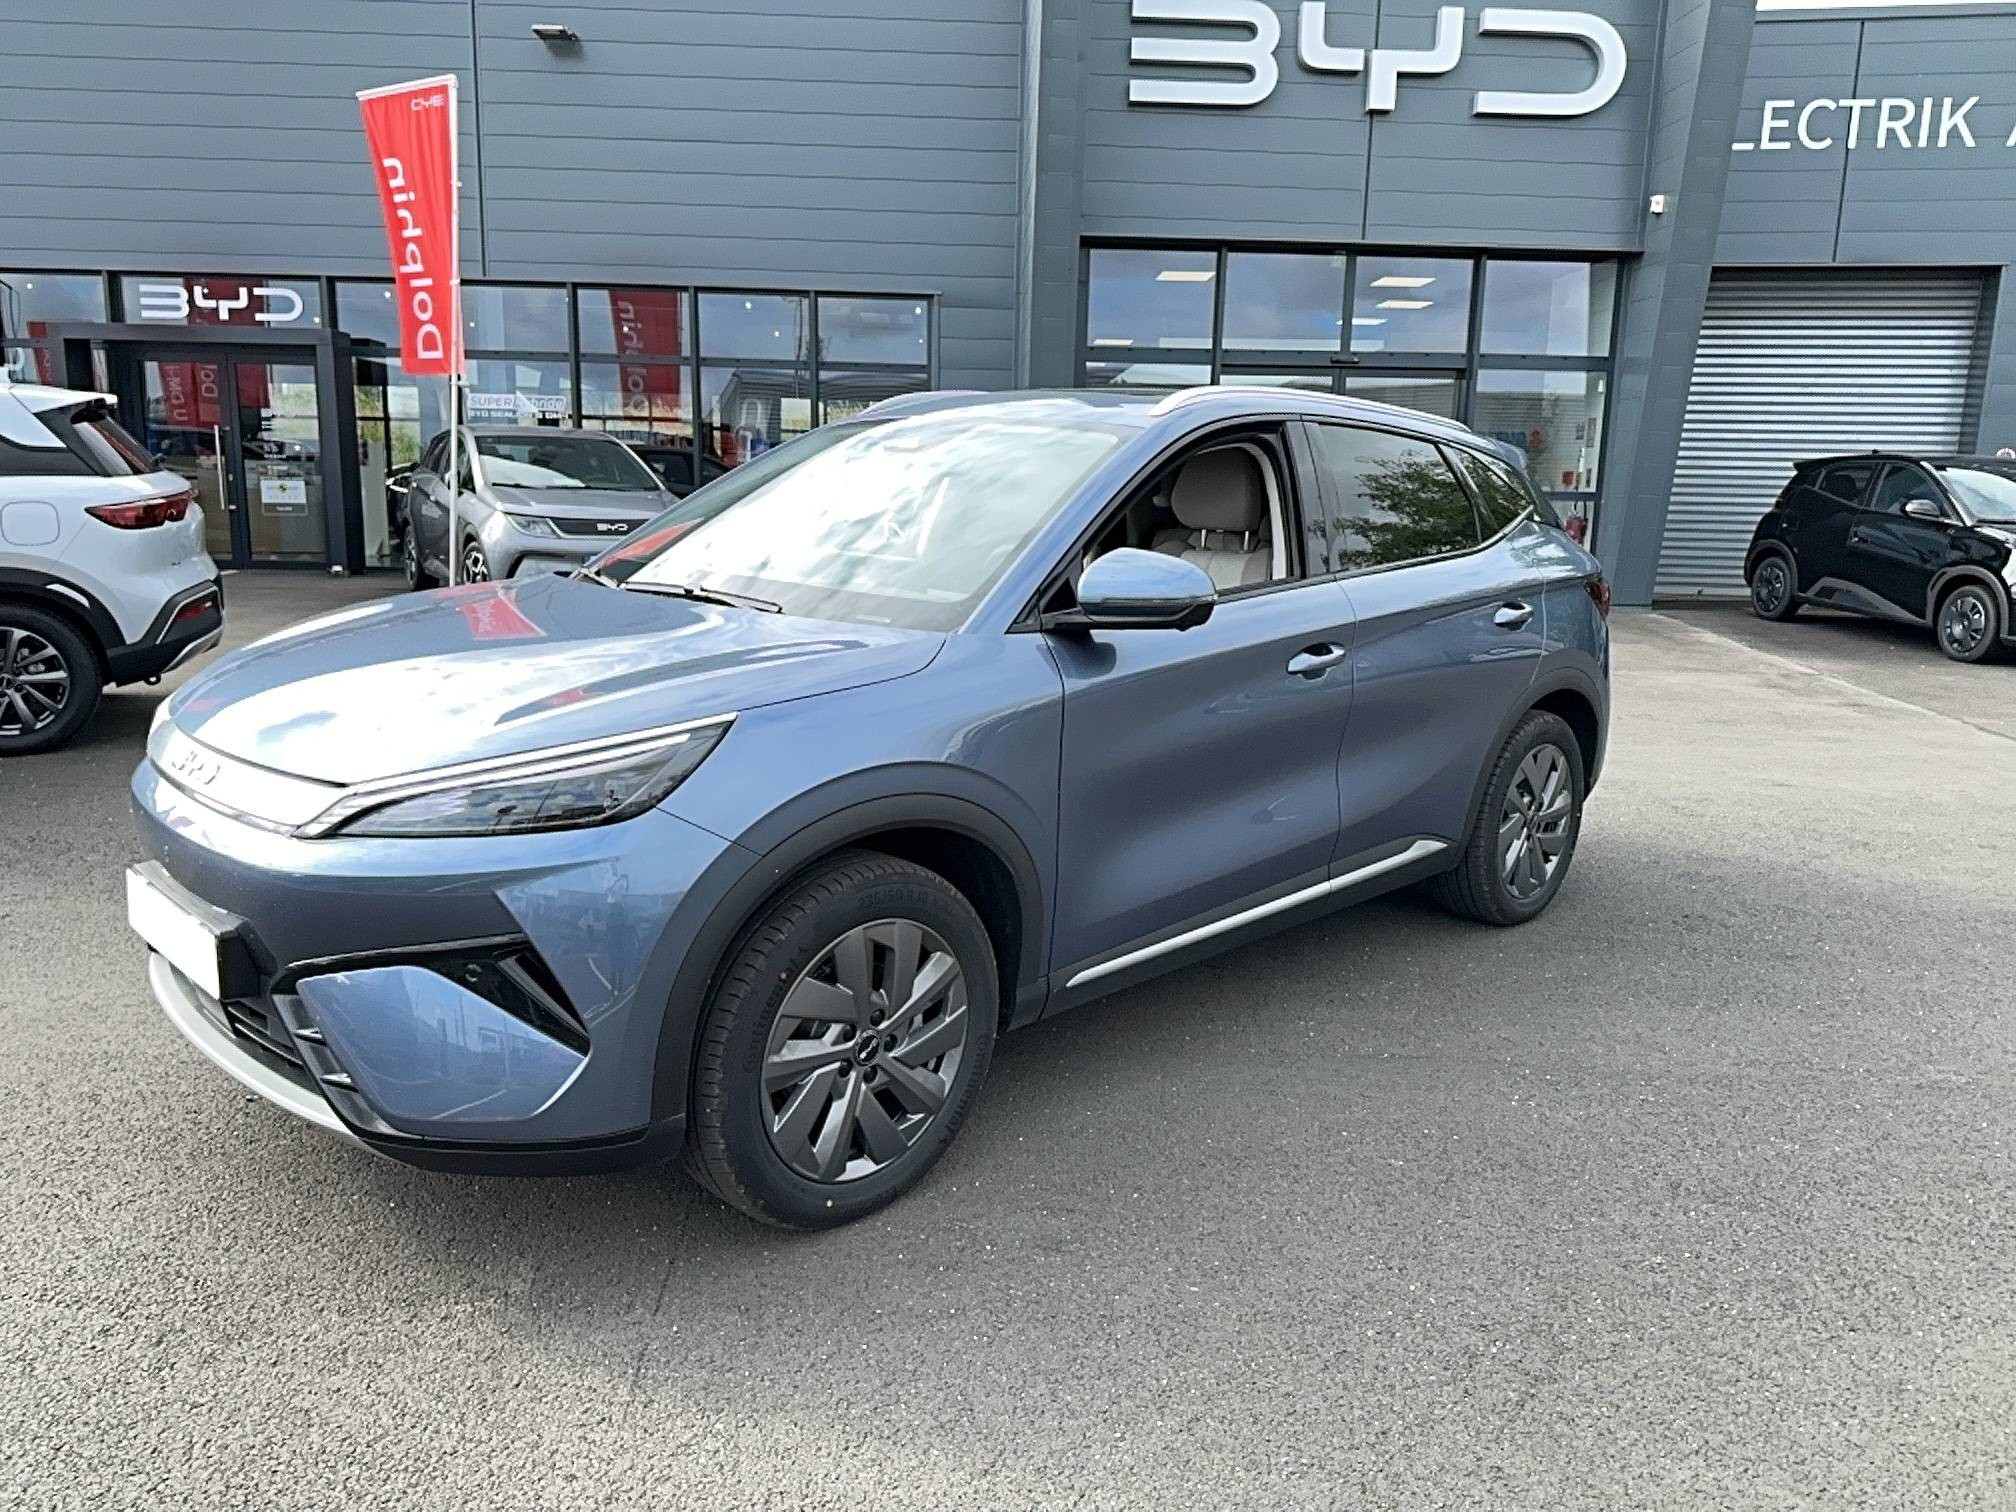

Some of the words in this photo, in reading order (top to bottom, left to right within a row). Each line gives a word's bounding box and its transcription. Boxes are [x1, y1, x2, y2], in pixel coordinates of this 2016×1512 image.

[1129, 0, 1628, 117] BYD
[139, 284, 303, 321] BYD
[470, 396, 513, 407] SUPER
[596, 523, 629, 532] BYD
